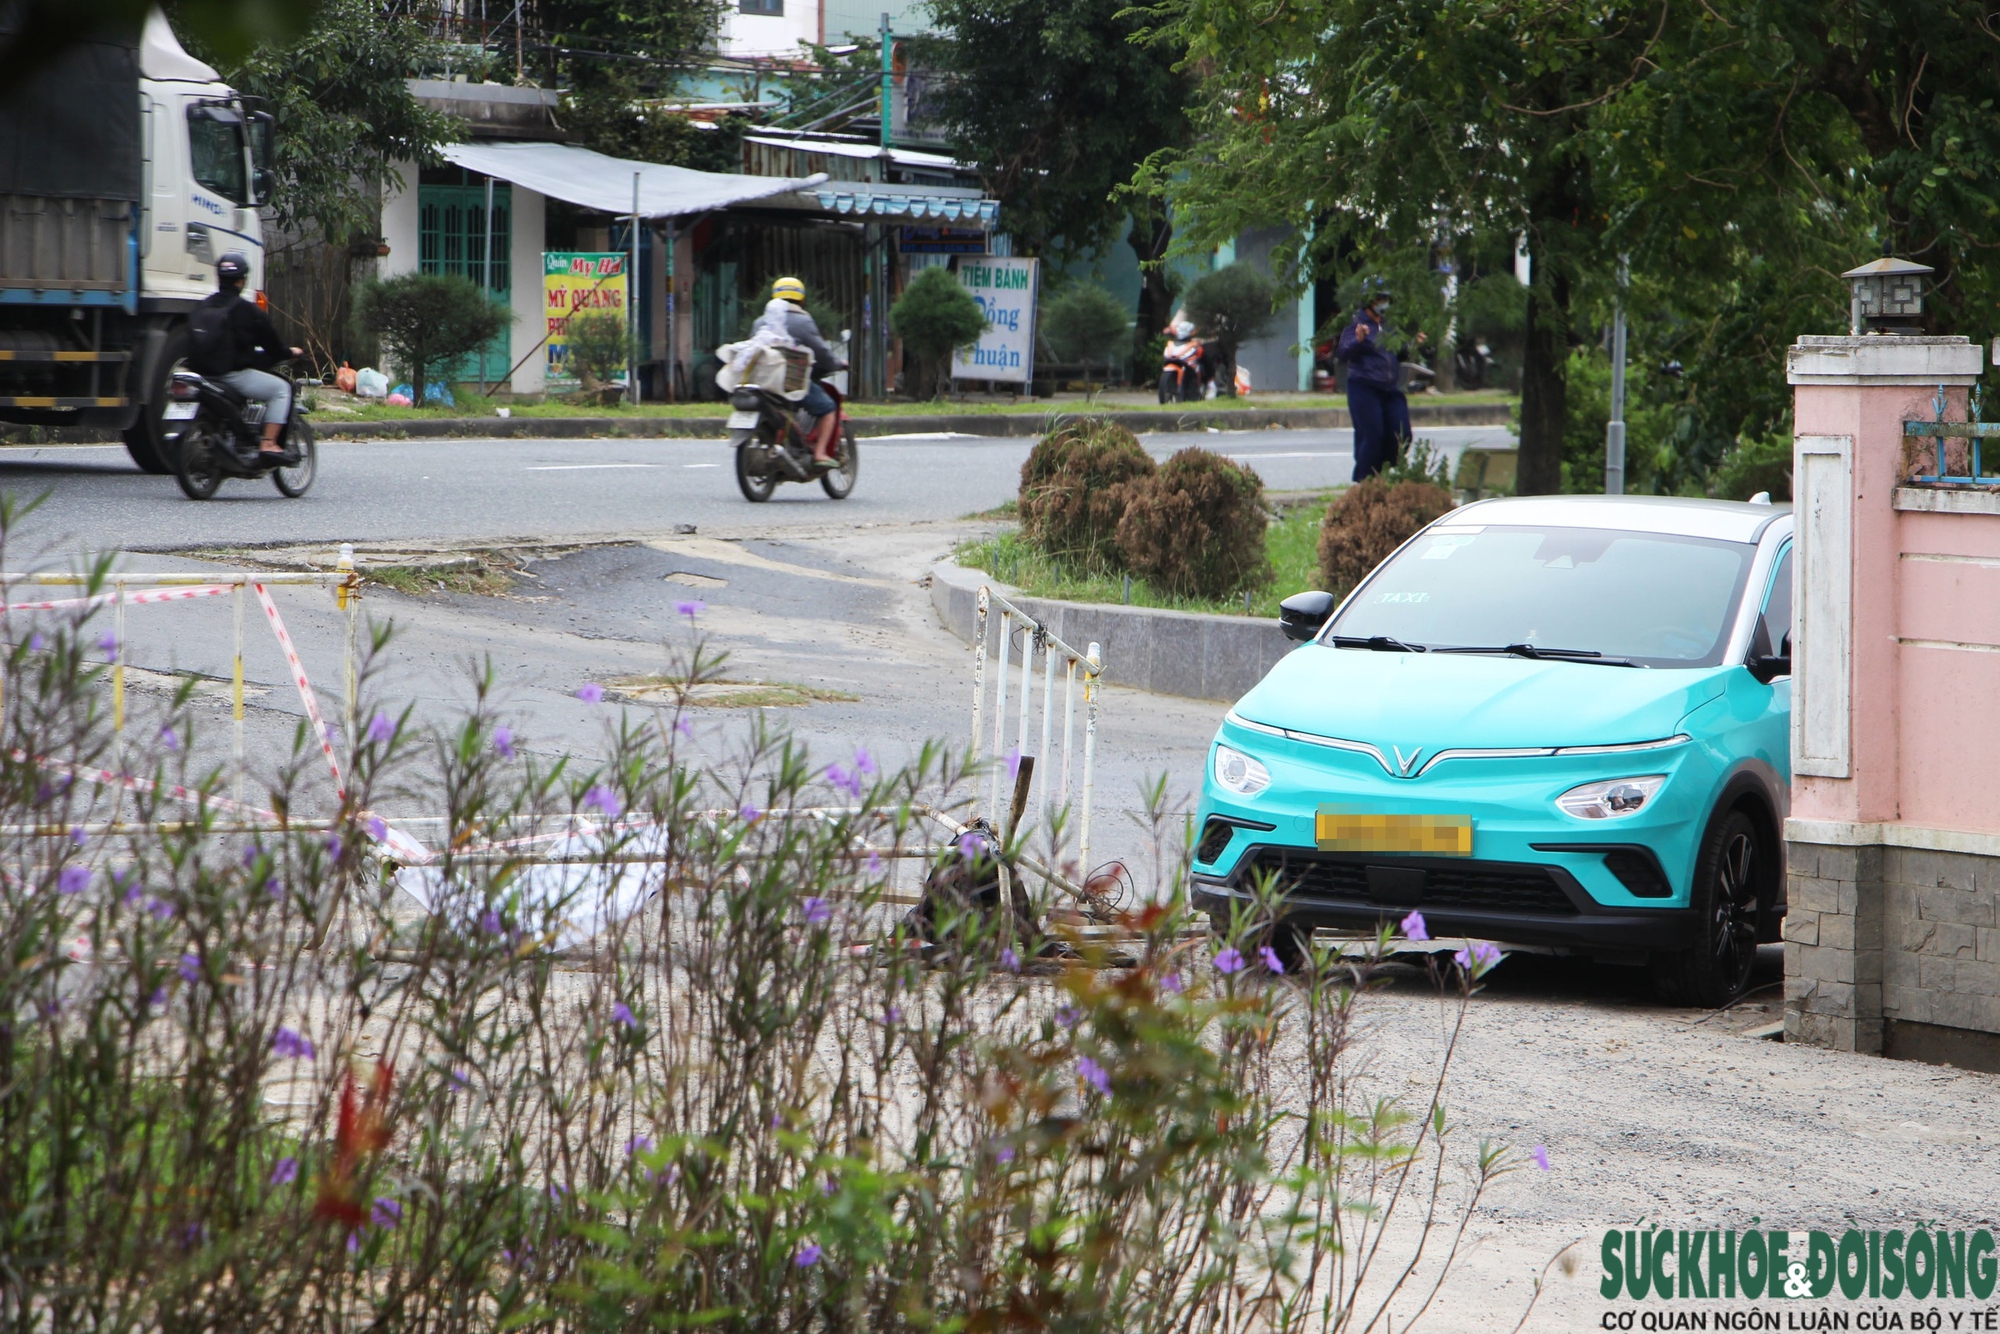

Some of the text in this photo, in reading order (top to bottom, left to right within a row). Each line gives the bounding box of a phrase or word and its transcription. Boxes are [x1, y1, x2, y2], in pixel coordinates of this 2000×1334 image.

[547, 254, 568, 270] Quán
[961, 261, 1028, 293] TIỆM BÁNH
[1381, 592, 1428, 603] TAXI
